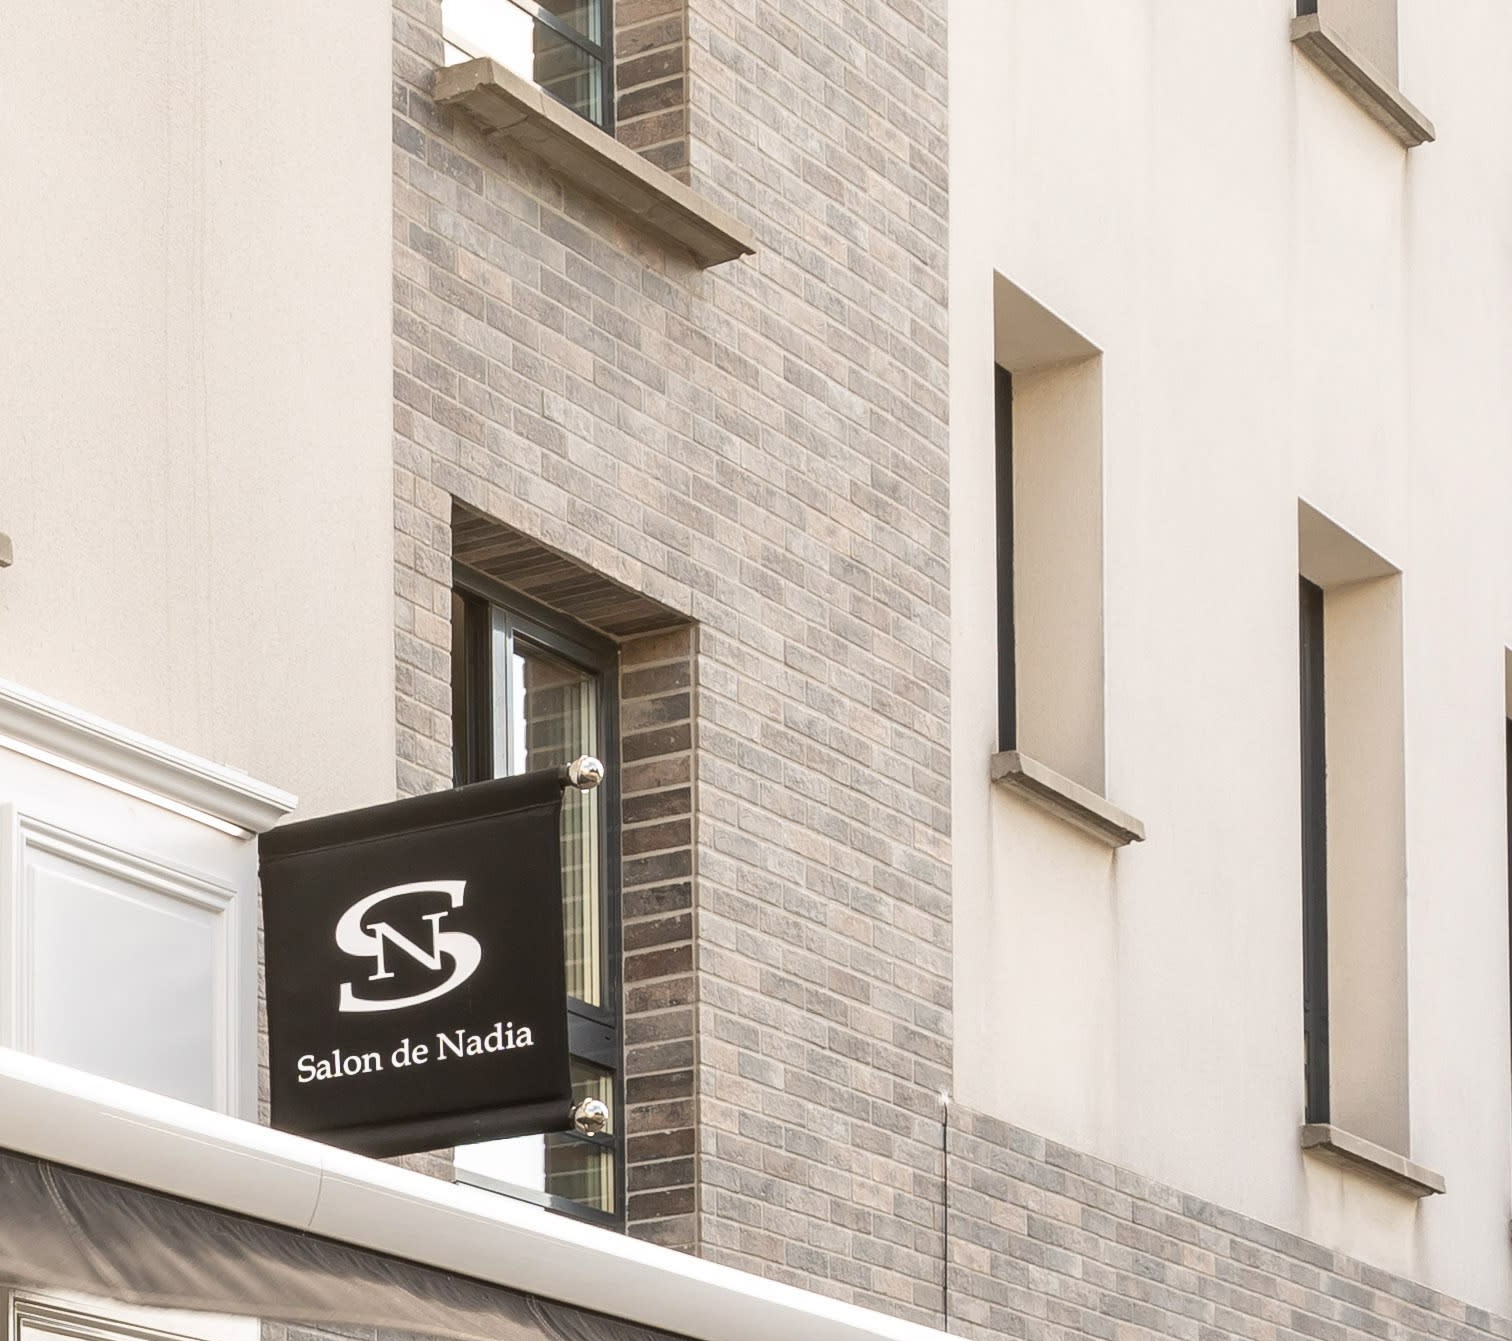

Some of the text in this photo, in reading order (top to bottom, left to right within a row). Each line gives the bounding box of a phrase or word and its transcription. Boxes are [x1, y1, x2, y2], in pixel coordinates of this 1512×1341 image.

[297, 1021, 534, 1083] Salon de Nadia
